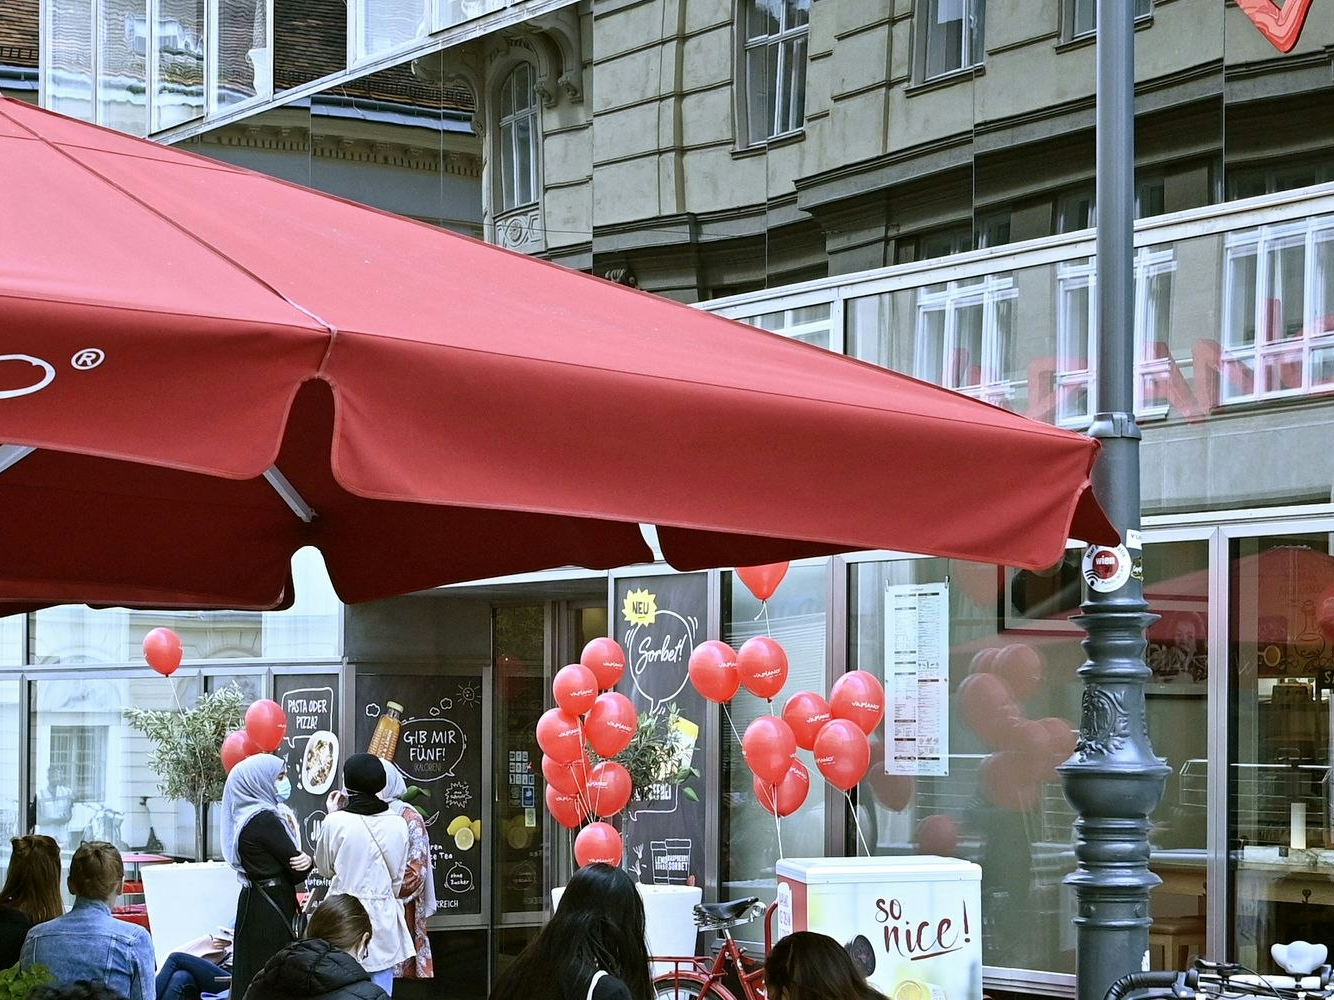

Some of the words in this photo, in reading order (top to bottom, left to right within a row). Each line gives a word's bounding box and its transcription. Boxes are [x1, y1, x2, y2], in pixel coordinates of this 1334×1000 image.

[632, 601, 649, 615] NEU
[635, 634, 687, 675] Sorbet!
[288, 700, 308, 713] PASTA
[308, 700, 327, 713] ODER
[296, 716, 318, 729] PIZZA?
[403, 730, 427, 745] GIB
[430, 730, 456, 745] MIR
[409, 745, 446, 761] FÜNF!
[875, 898, 902, 924] so
